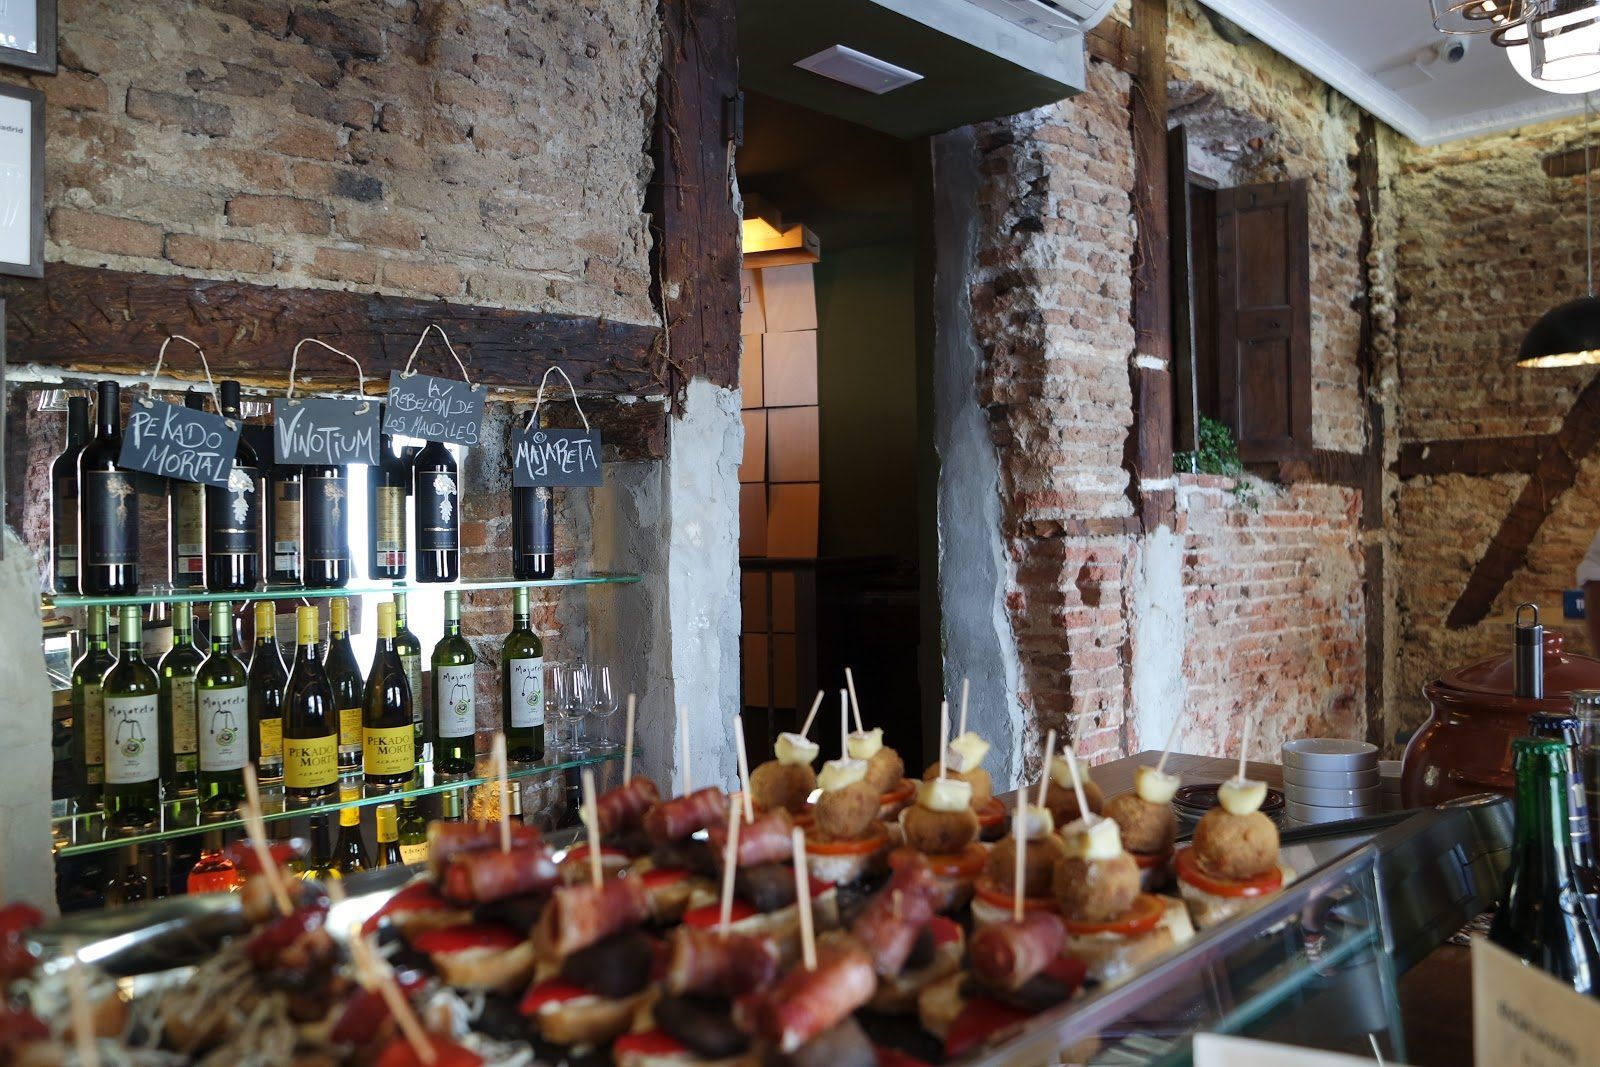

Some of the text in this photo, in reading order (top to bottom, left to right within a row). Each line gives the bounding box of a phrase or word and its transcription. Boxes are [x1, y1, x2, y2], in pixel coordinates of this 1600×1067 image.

[0, 124, 24, 134] adrid
[130, 404, 223, 450] PEKADO
[142, 444, 230, 482] MORTAL
[367, 735, 409, 746] PEKADO
[289, 744, 334, 757] PEKADO
[301, 754, 337, 767] MORTA
